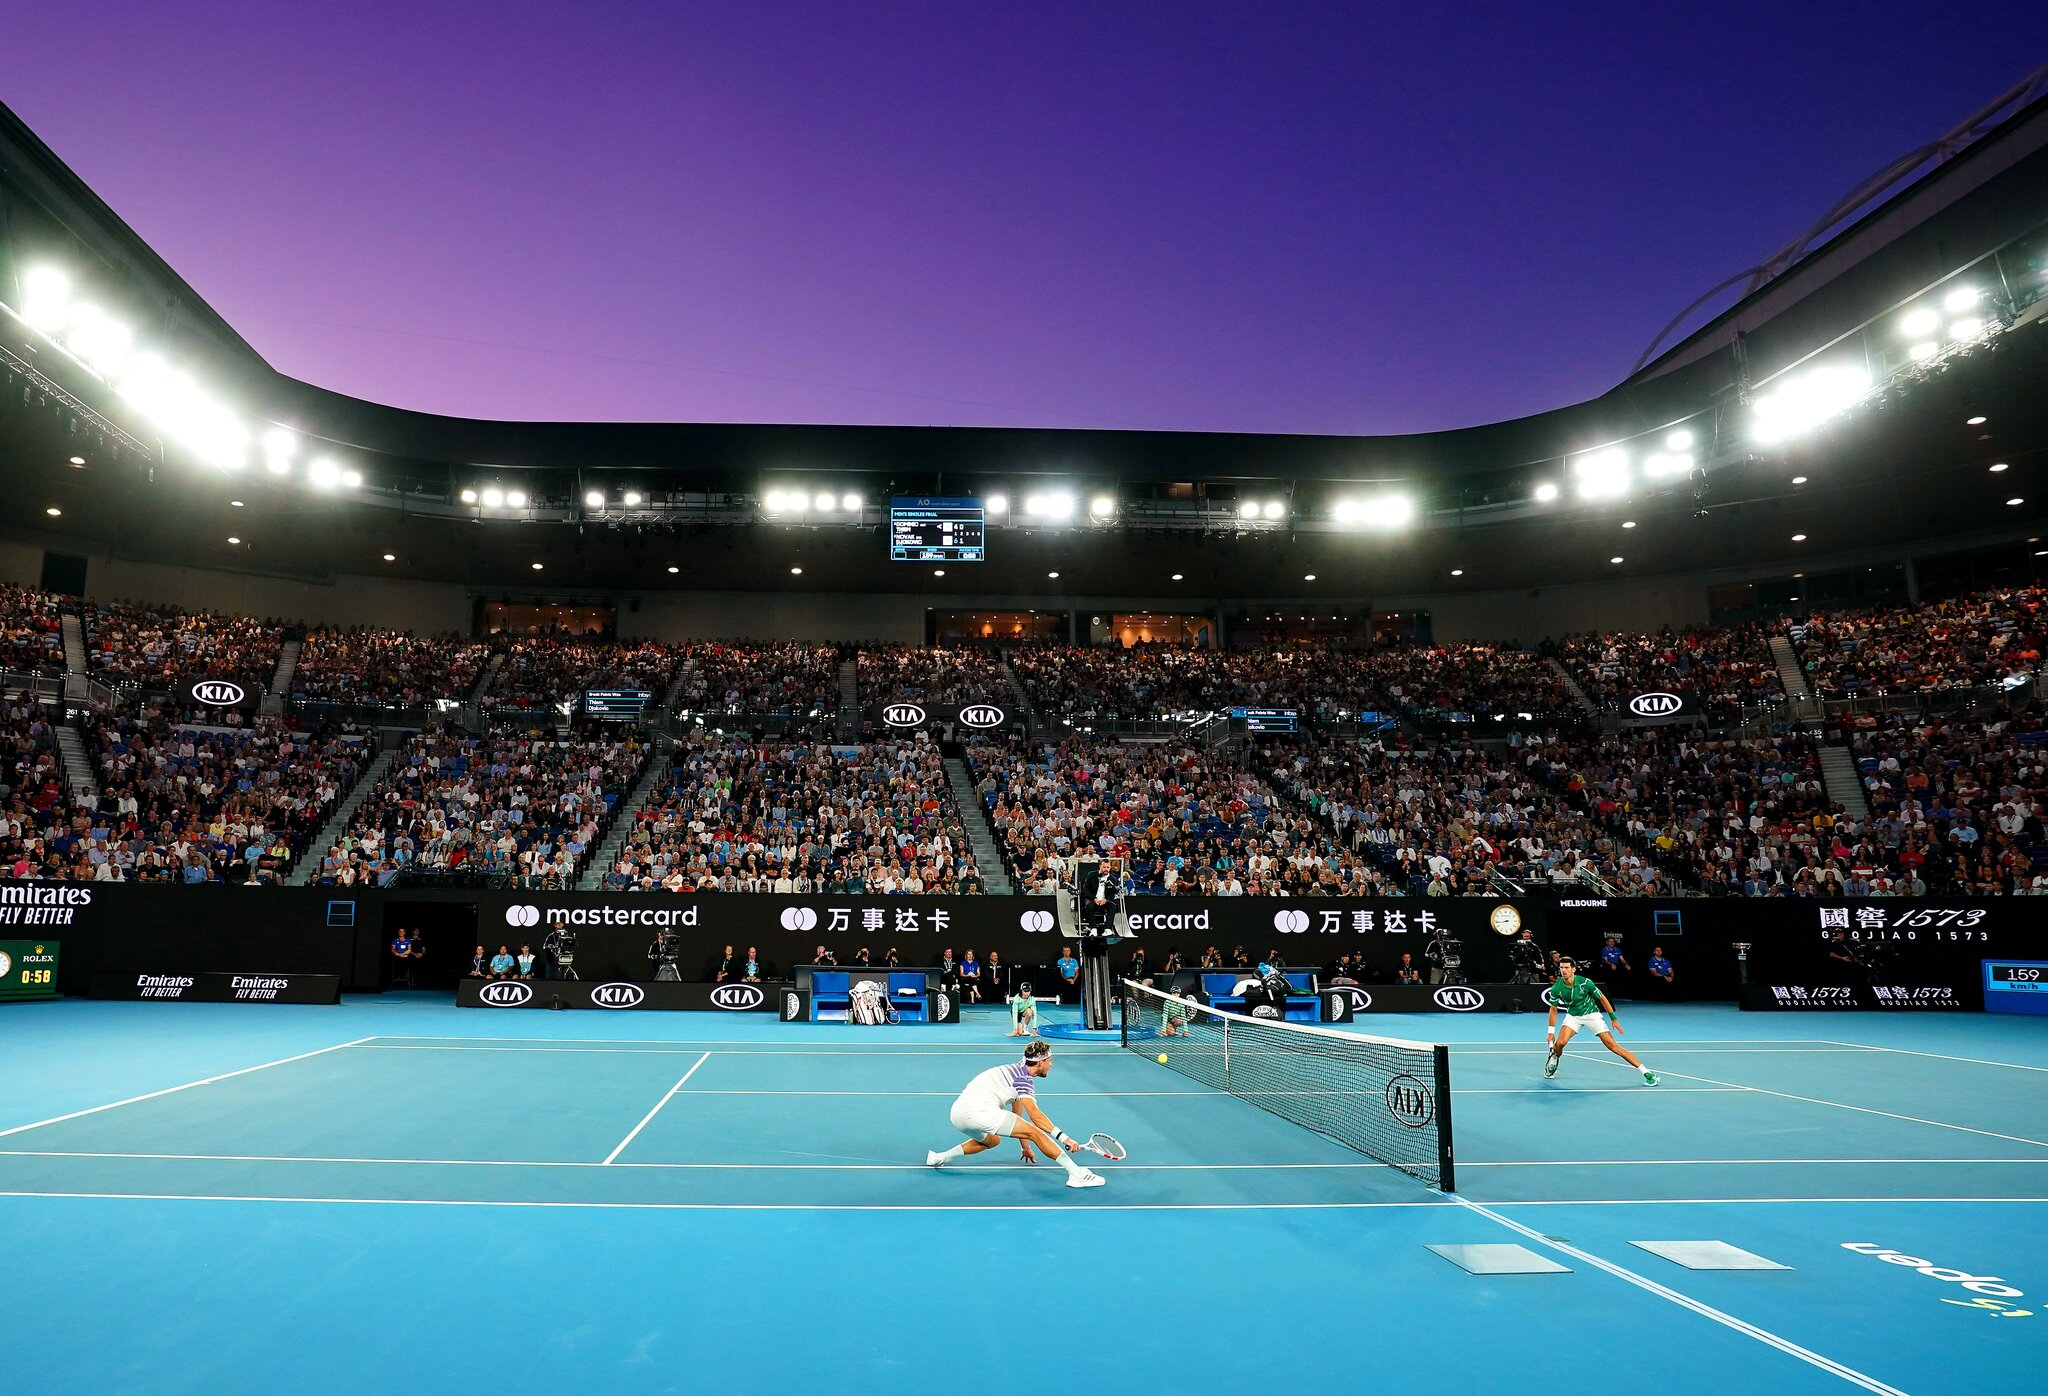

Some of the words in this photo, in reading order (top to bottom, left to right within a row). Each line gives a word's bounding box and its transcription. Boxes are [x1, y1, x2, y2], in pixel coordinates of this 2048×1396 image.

[202, 686, 235, 700] KIA
[1639, 697, 1673, 711] KIA
[889, 709, 918, 721] KIA
[967, 710, 996, 722] KIA
[0, 883, 91, 905] mirates
[0, 907, 22, 925] FLY
[24, 907, 74, 925] BETTER
[546, 905, 698, 926] mastercard
[827, 908, 950, 933] 万事达卡
[1128, 909, 1210, 930] ercard
[1319, 910, 1437, 933] 万事达卡
[1821, 930, 1916, 940] GOJIAO
[1935, 931, 1988, 941] 1573
[21, 970, 51, 983] 0:58
[137, 974, 194, 987] Emirates
[2007, 969, 2040, 981] 159
[231, 976, 289, 989] Emirates
[141, 987, 154, 997] FLY
[155, 987, 183, 998] BETTER
[235, 989, 249, 999] FLY
[249, 989, 277, 1000] BETTER
[488, 986, 523, 1001] KIA
[600, 988, 635, 1002] KIA
[720, 989, 754, 1004] KIA
[1442, 991, 1478, 1005] KIA
[1840, 1242, 2024, 1297] open
